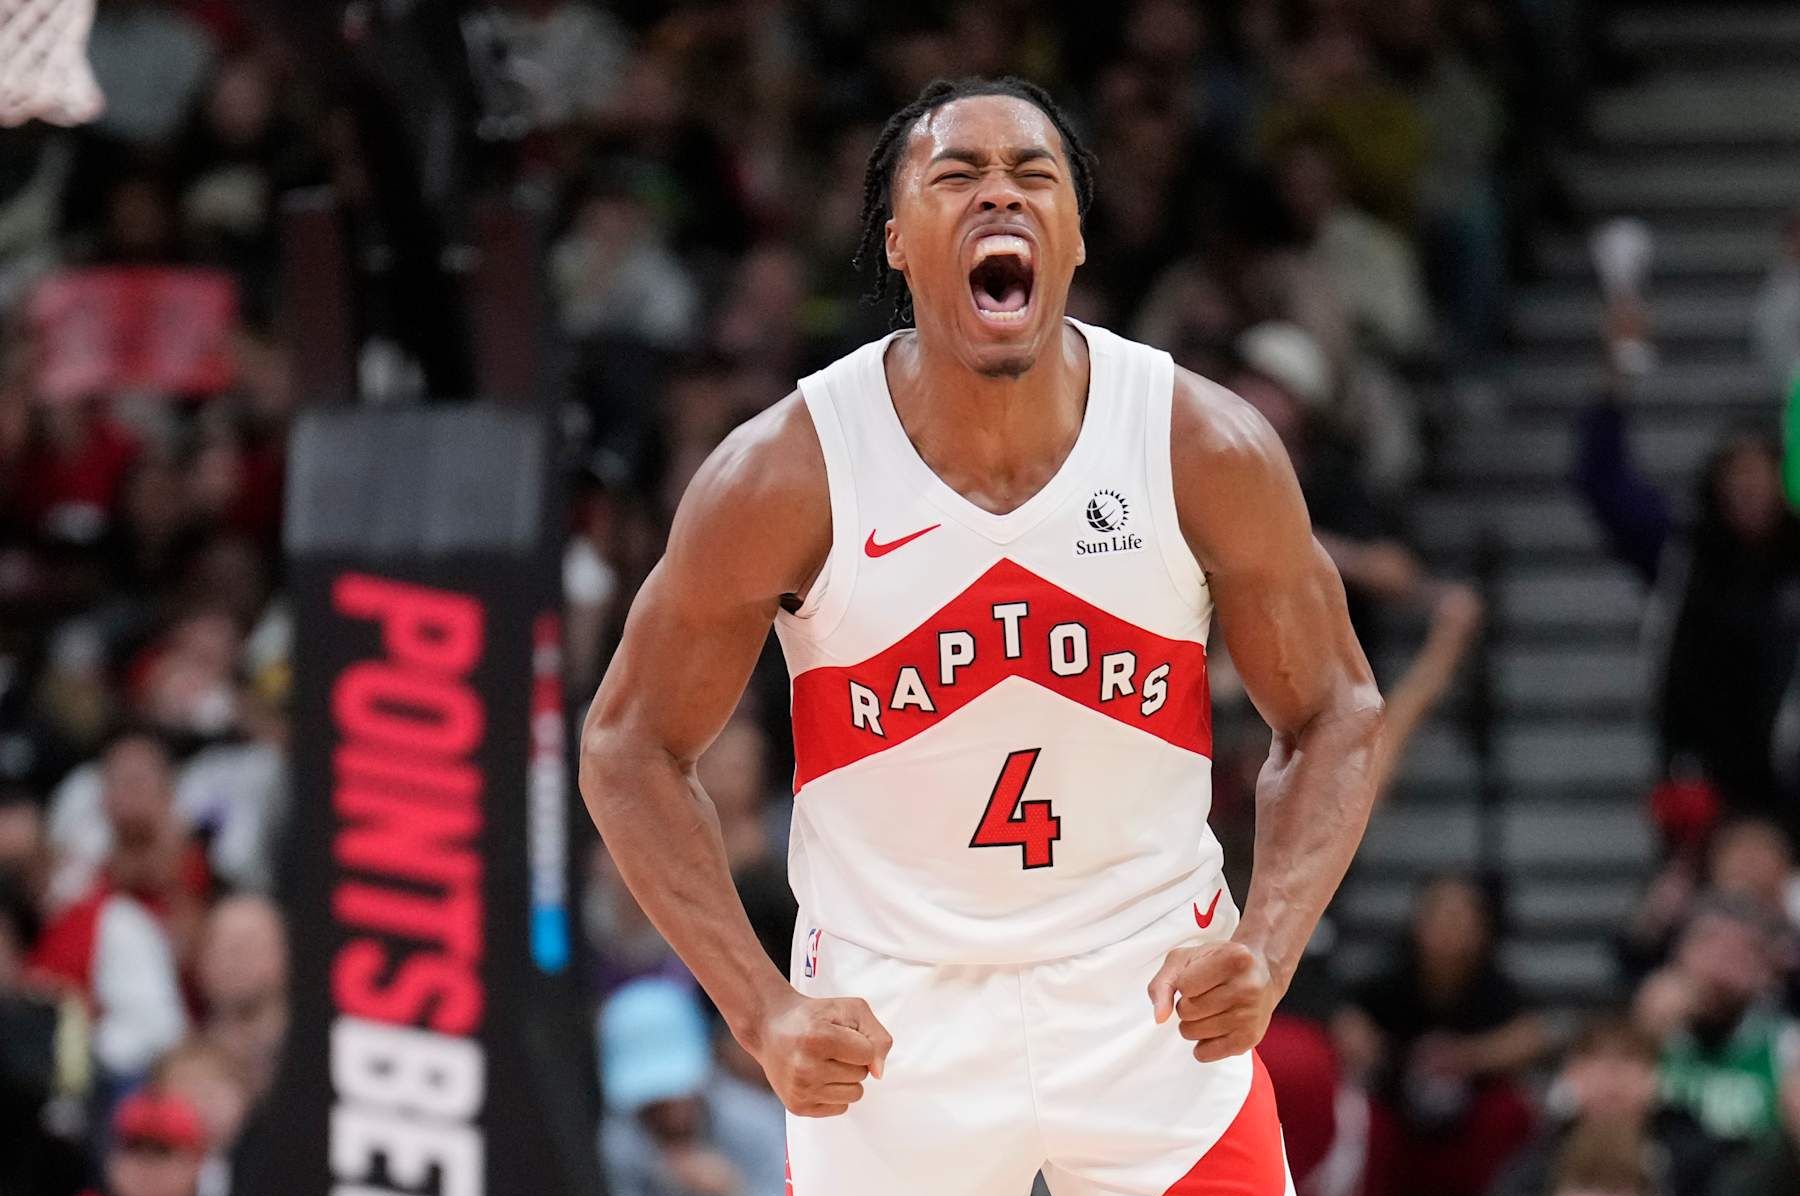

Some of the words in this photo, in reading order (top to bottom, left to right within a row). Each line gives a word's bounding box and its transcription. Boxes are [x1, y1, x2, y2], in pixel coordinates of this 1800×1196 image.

[1076, 540, 1109, 555] Sun
[1112, 533, 1142, 551] Life
[848, 602, 1171, 738] RAPTORS
[968, 747, 1061, 870] 4
